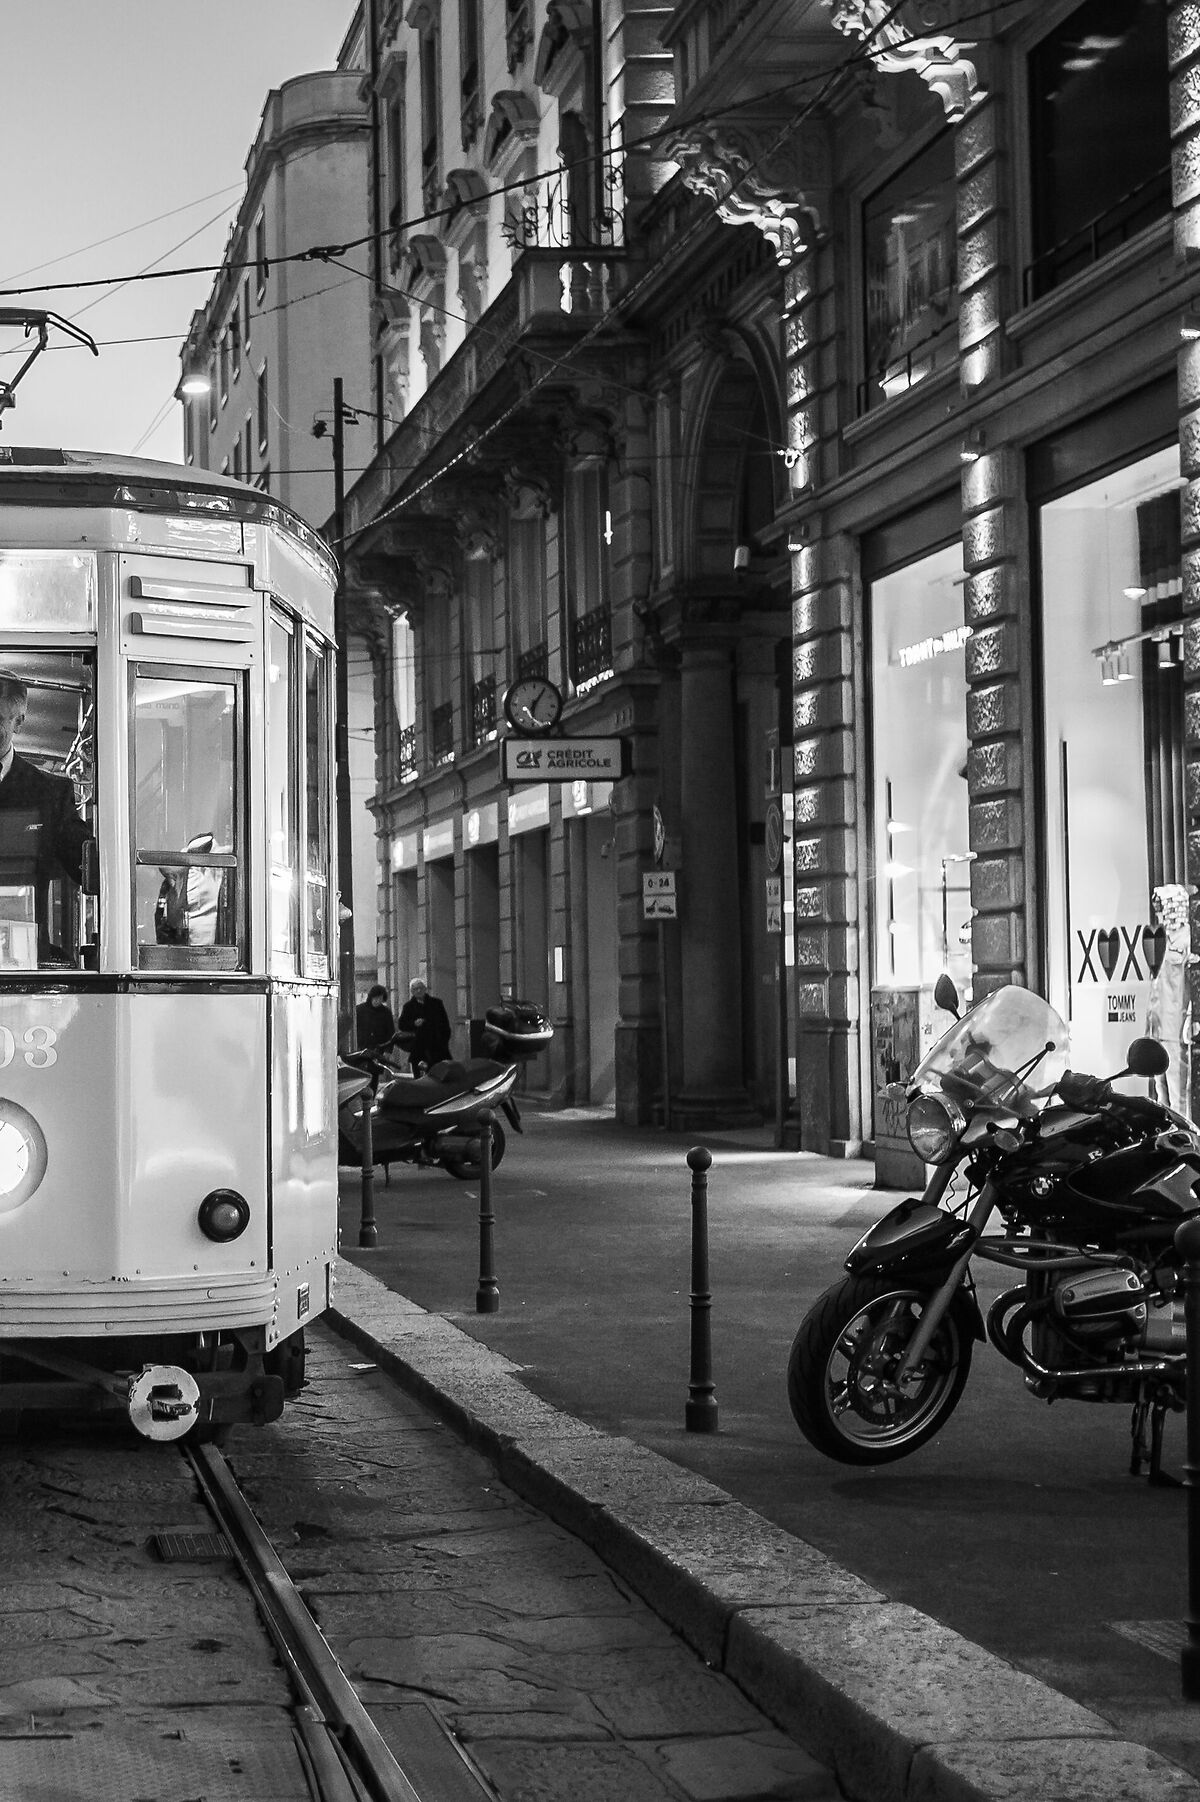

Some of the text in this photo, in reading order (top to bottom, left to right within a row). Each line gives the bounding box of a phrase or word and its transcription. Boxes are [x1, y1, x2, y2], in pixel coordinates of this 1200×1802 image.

[547, 747, 594, 759] CRÉDIT
[547, 758, 612, 769] AGRICOLE
[1108, 995, 1136, 1010] TOMMY
[1119, 1012, 1136, 1022] JEANS
